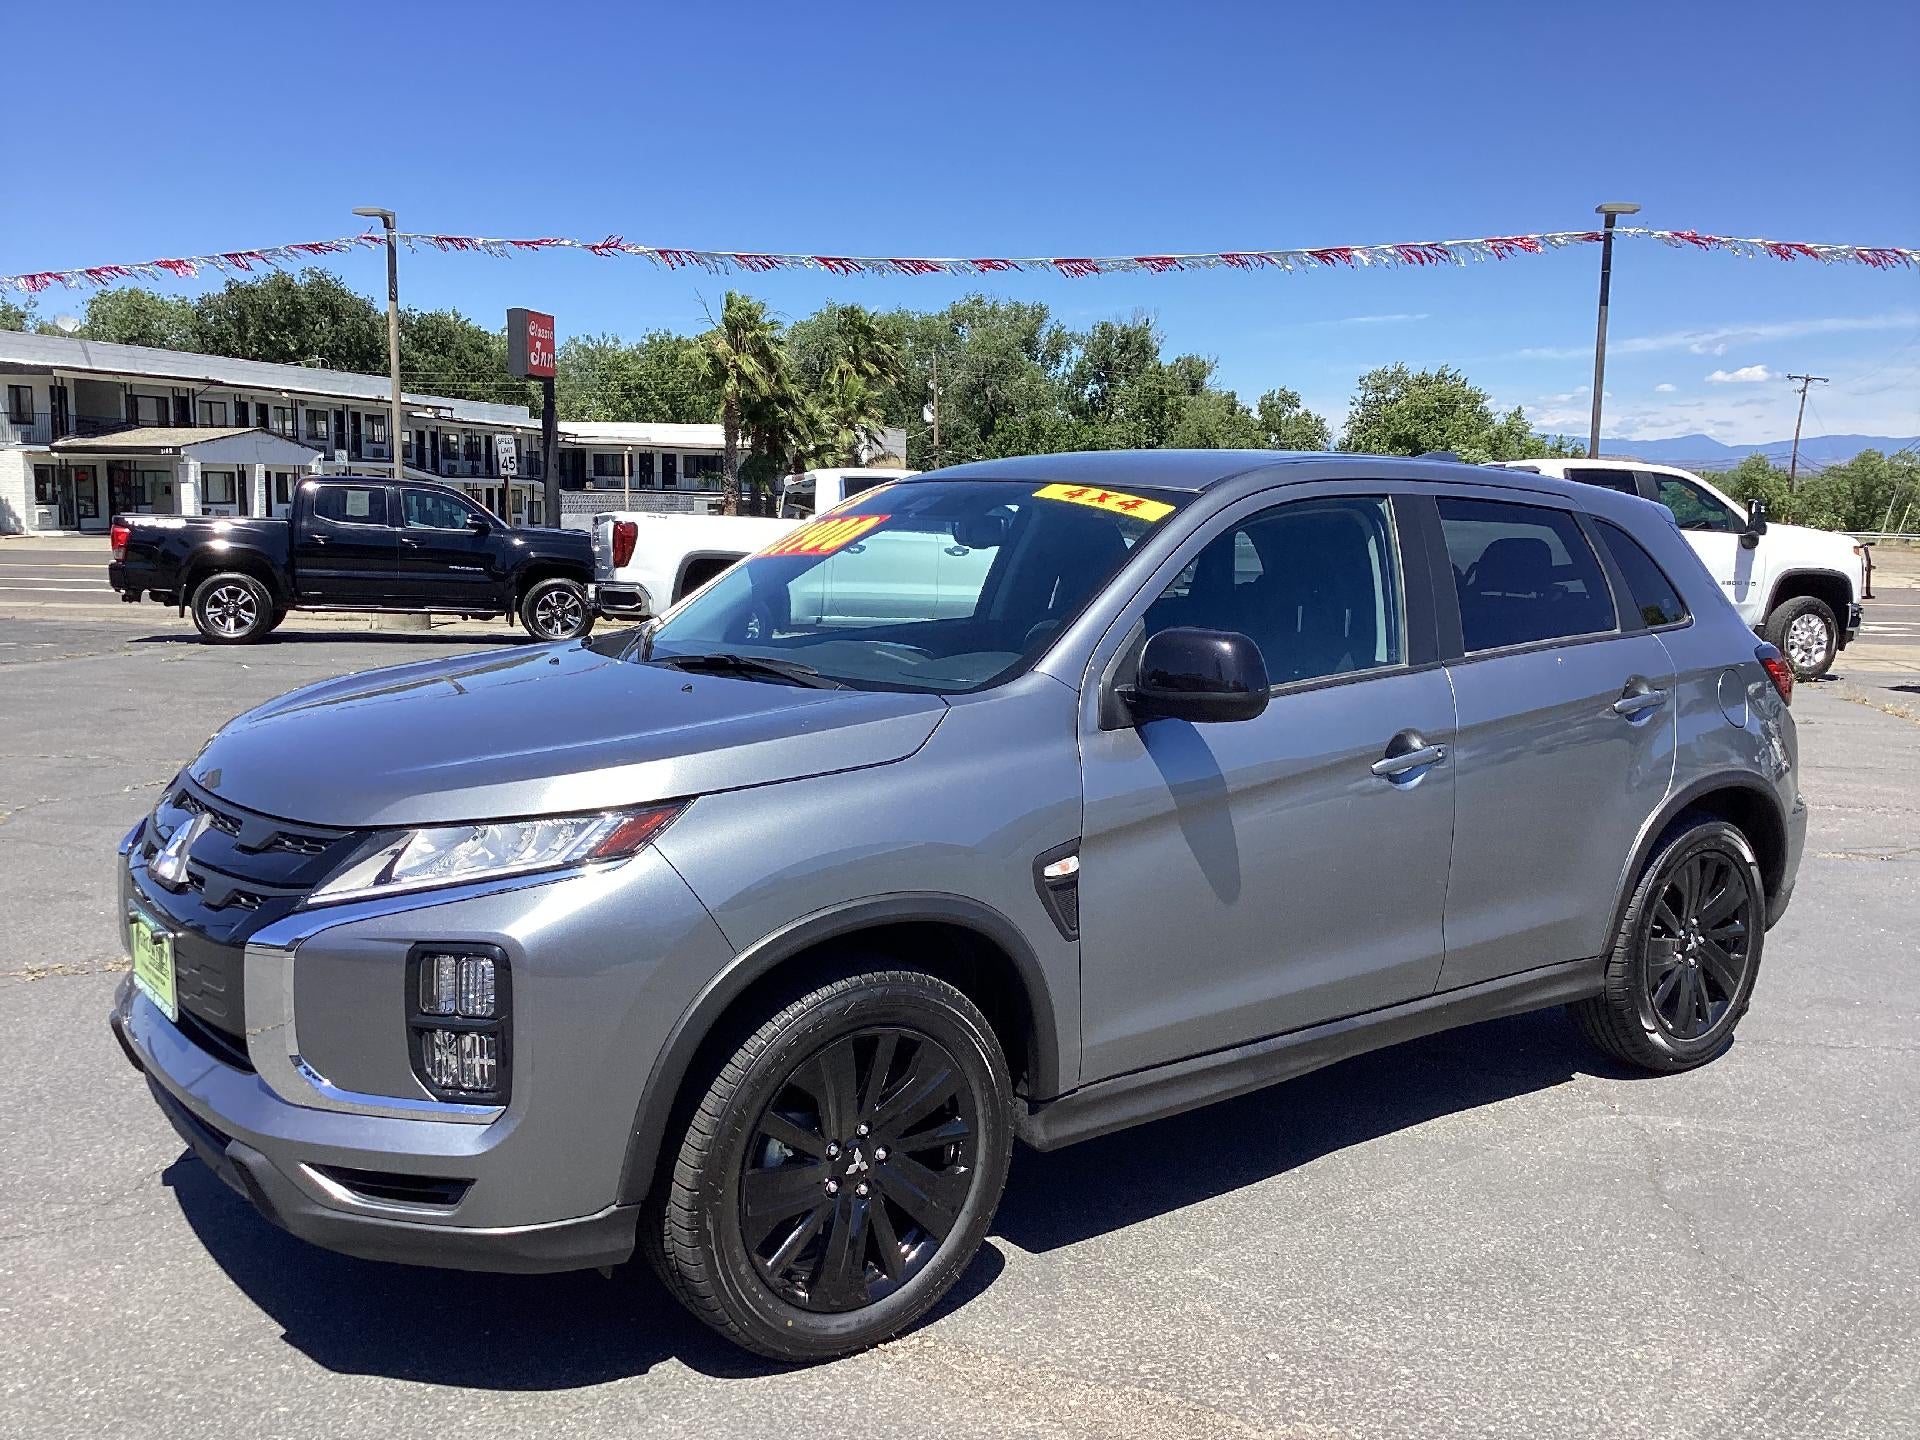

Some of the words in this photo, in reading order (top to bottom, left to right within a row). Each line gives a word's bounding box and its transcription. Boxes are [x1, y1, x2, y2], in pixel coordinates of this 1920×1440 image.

[529, 320, 553, 340] Classic
[530, 341, 553, 368] Inn
[502, 456, 516, 471] 45
